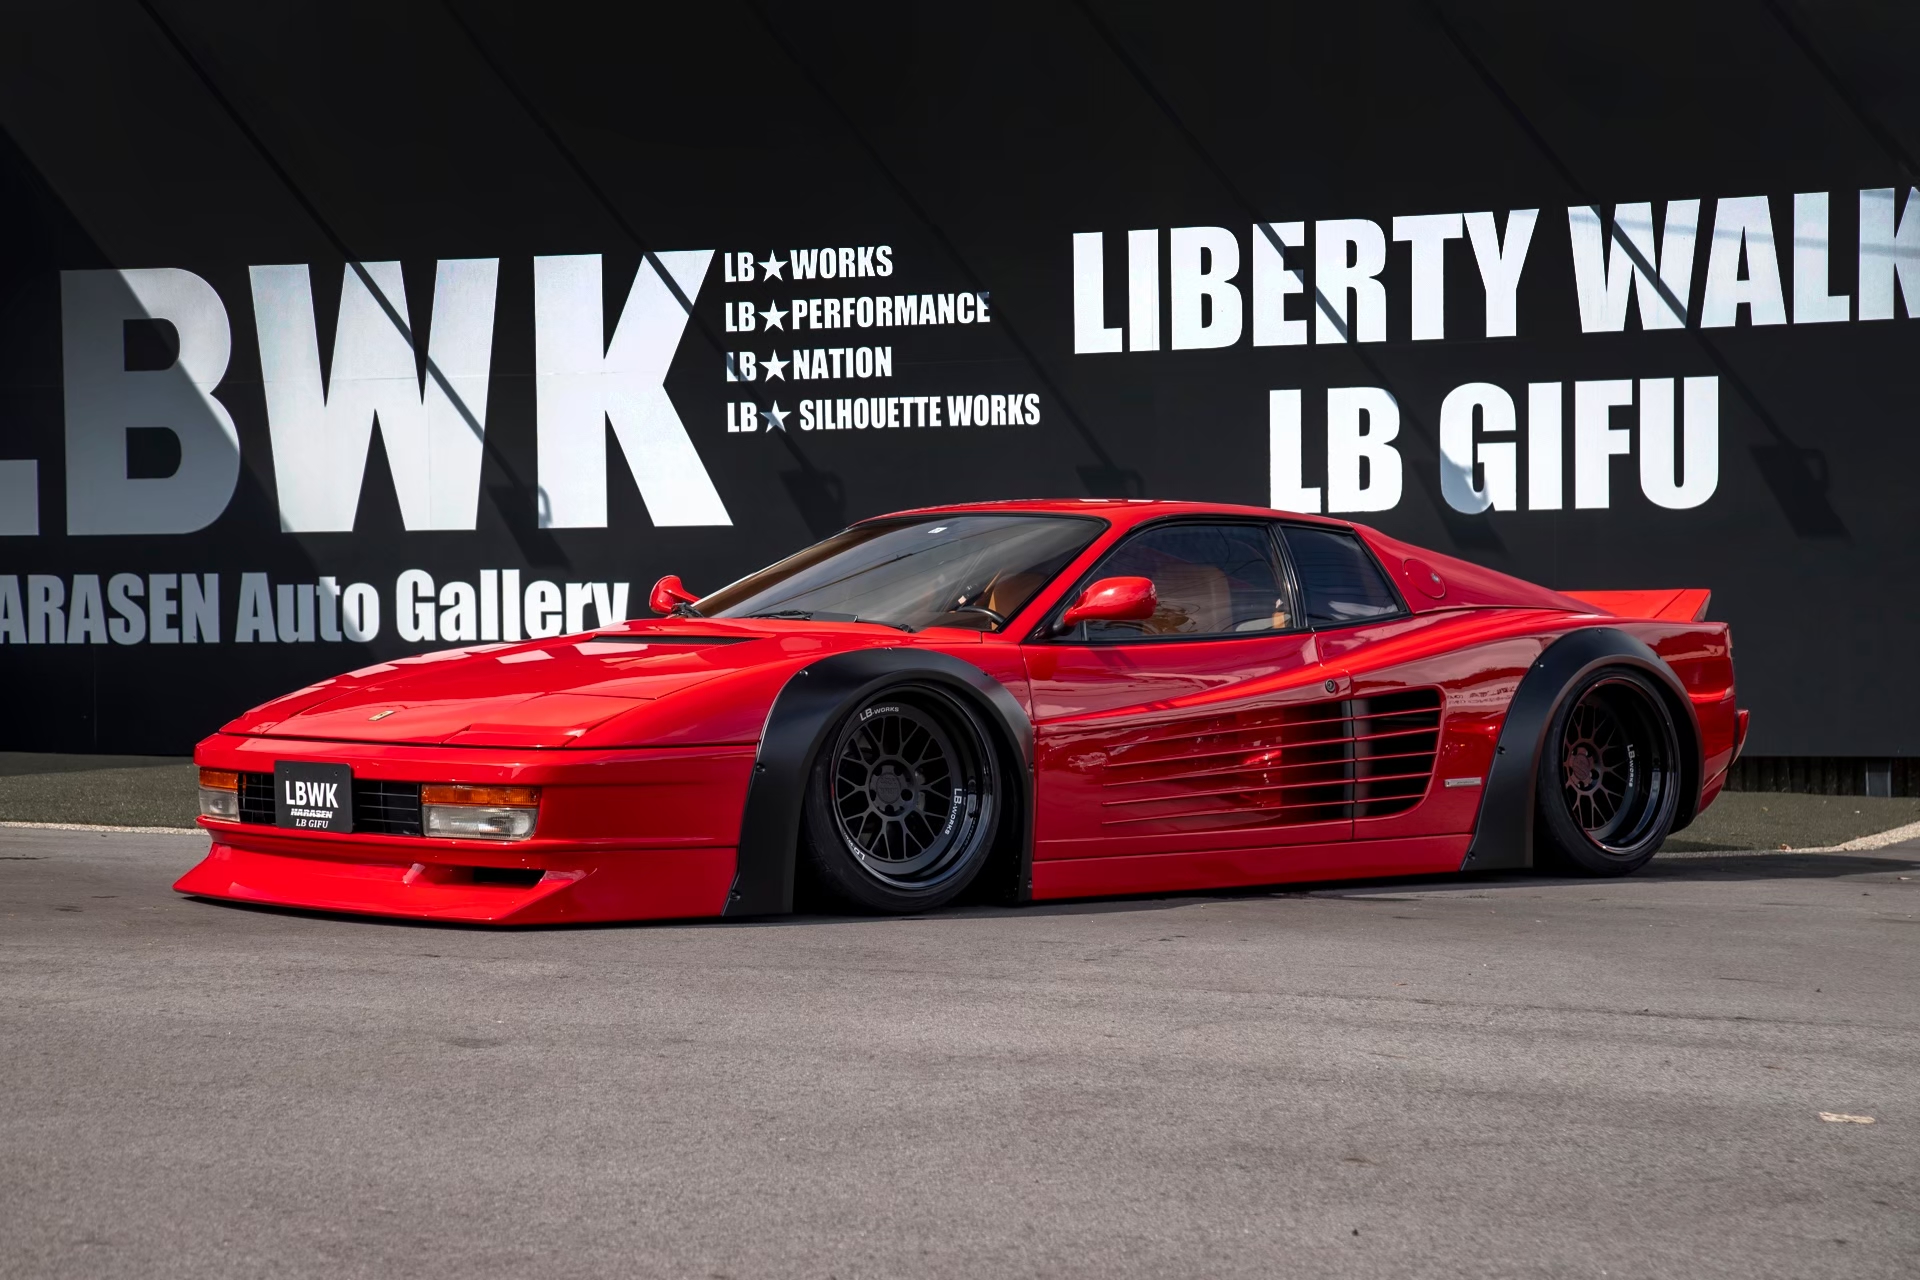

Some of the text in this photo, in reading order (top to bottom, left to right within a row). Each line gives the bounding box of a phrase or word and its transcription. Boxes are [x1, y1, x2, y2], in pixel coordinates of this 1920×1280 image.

[724, 245, 894, 283] LB WORKS
[1073, 186, 1920, 355] LIBERTY WALK
[725, 291, 991, 333] LB PERFORMANCE
[726, 346, 893, 383] LB NATION
[0, 250, 734, 537] BWK
[727, 394, 1041, 433] LB SILHOUETTE WORKS
[1269, 376, 1719, 515] LB GIFU
[235, 572, 381, 644] Auto
[285, 780, 339, 809] LBWK
[296, 818, 329, 829] LB GIFU
